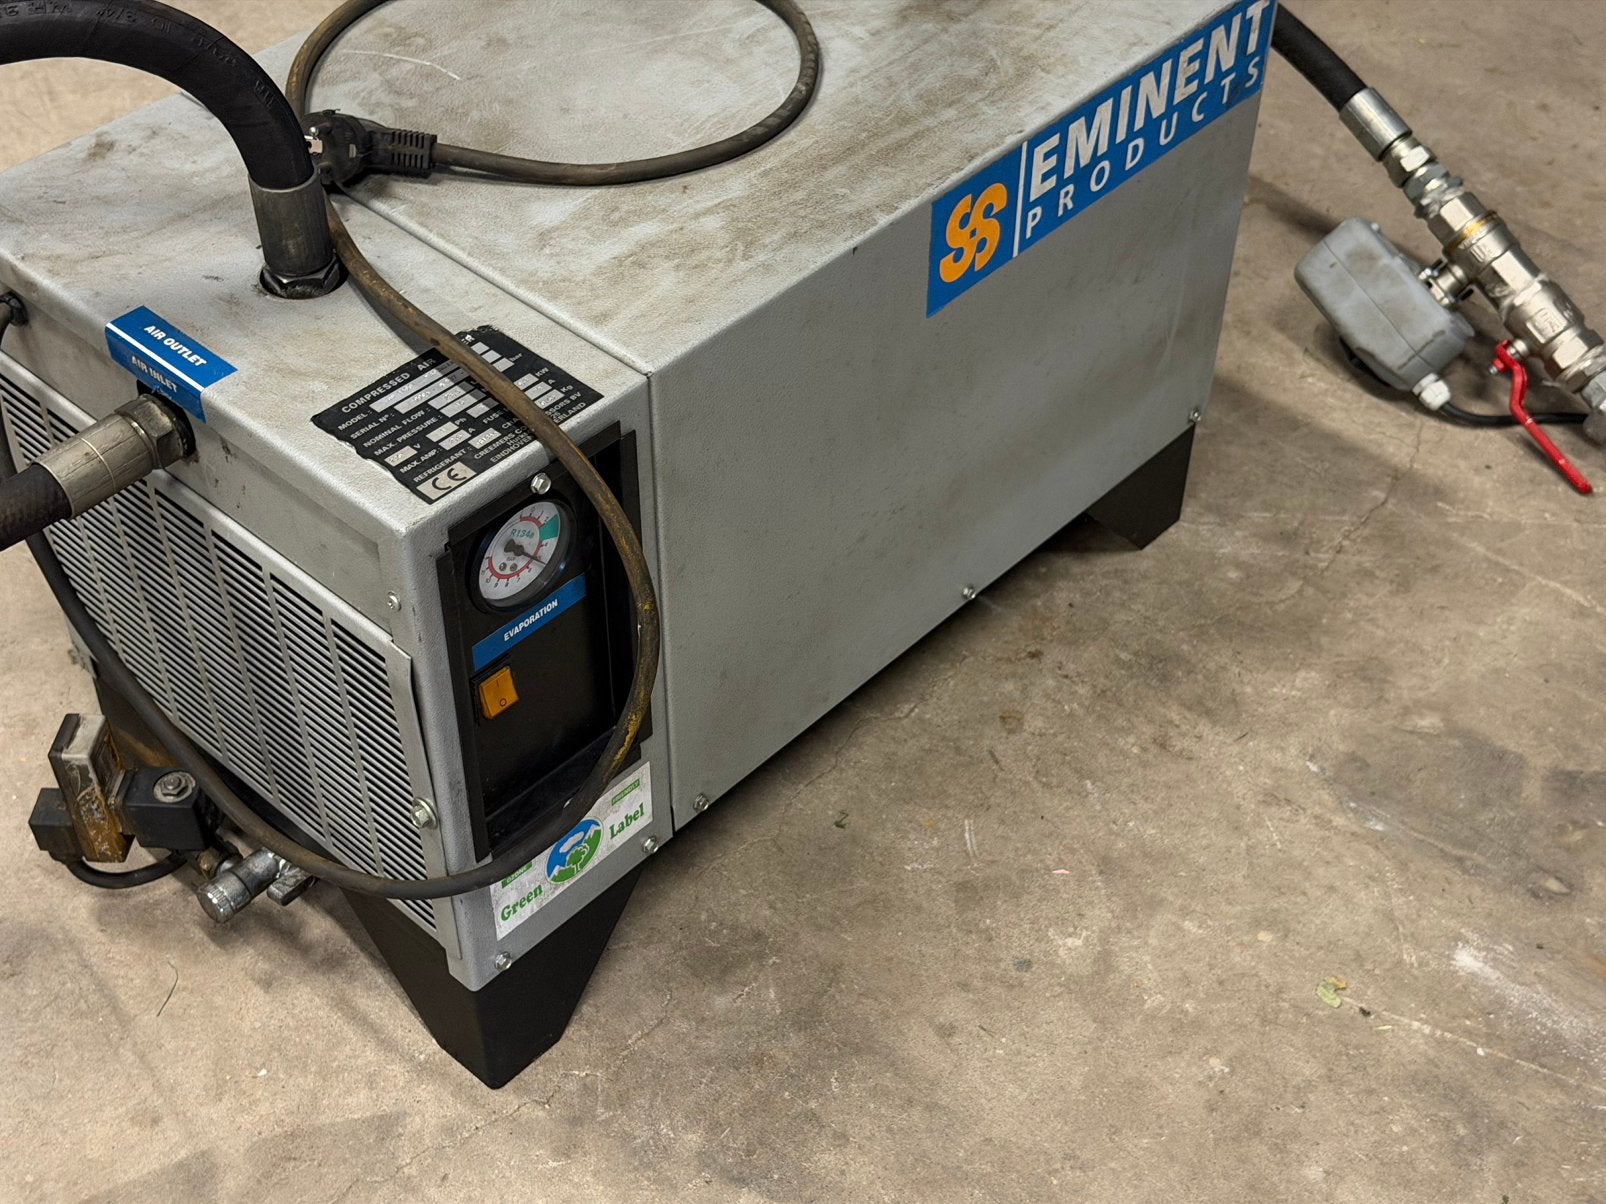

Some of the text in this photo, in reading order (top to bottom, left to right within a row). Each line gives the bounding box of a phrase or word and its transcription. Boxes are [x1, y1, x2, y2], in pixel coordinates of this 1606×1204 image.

[1029, 0, 1270, 202] EMINENT
[1025, 56, 1259, 239] PRODUCTS
[143, 325, 208, 367] AIR OUTLET
[131, 355, 178, 393] AIR INLET
[339, 372, 413, 413] COMPRESSED
[415, 358, 437, 371] AIR
[337, 411, 369, 430] MODEL
[349, 421, 380, 439] SERIAL
[361, 423, 402, 447] NOMINAL
[401, 410, 426, 425] FLOW
[372, 440, 397, 456] MAX.
[395, 416, 439, 442] PRESSURE
[472, 432, 517, 459] CREEMERS
[568, 391, 583, 400] BV
[412, 448, 468, 483] REFRIGERANT
[510, 528, 534, 538] R134a
[503, 599, 559, 642] EVAPORATION
[501, 802, 646, 921] Green Label
